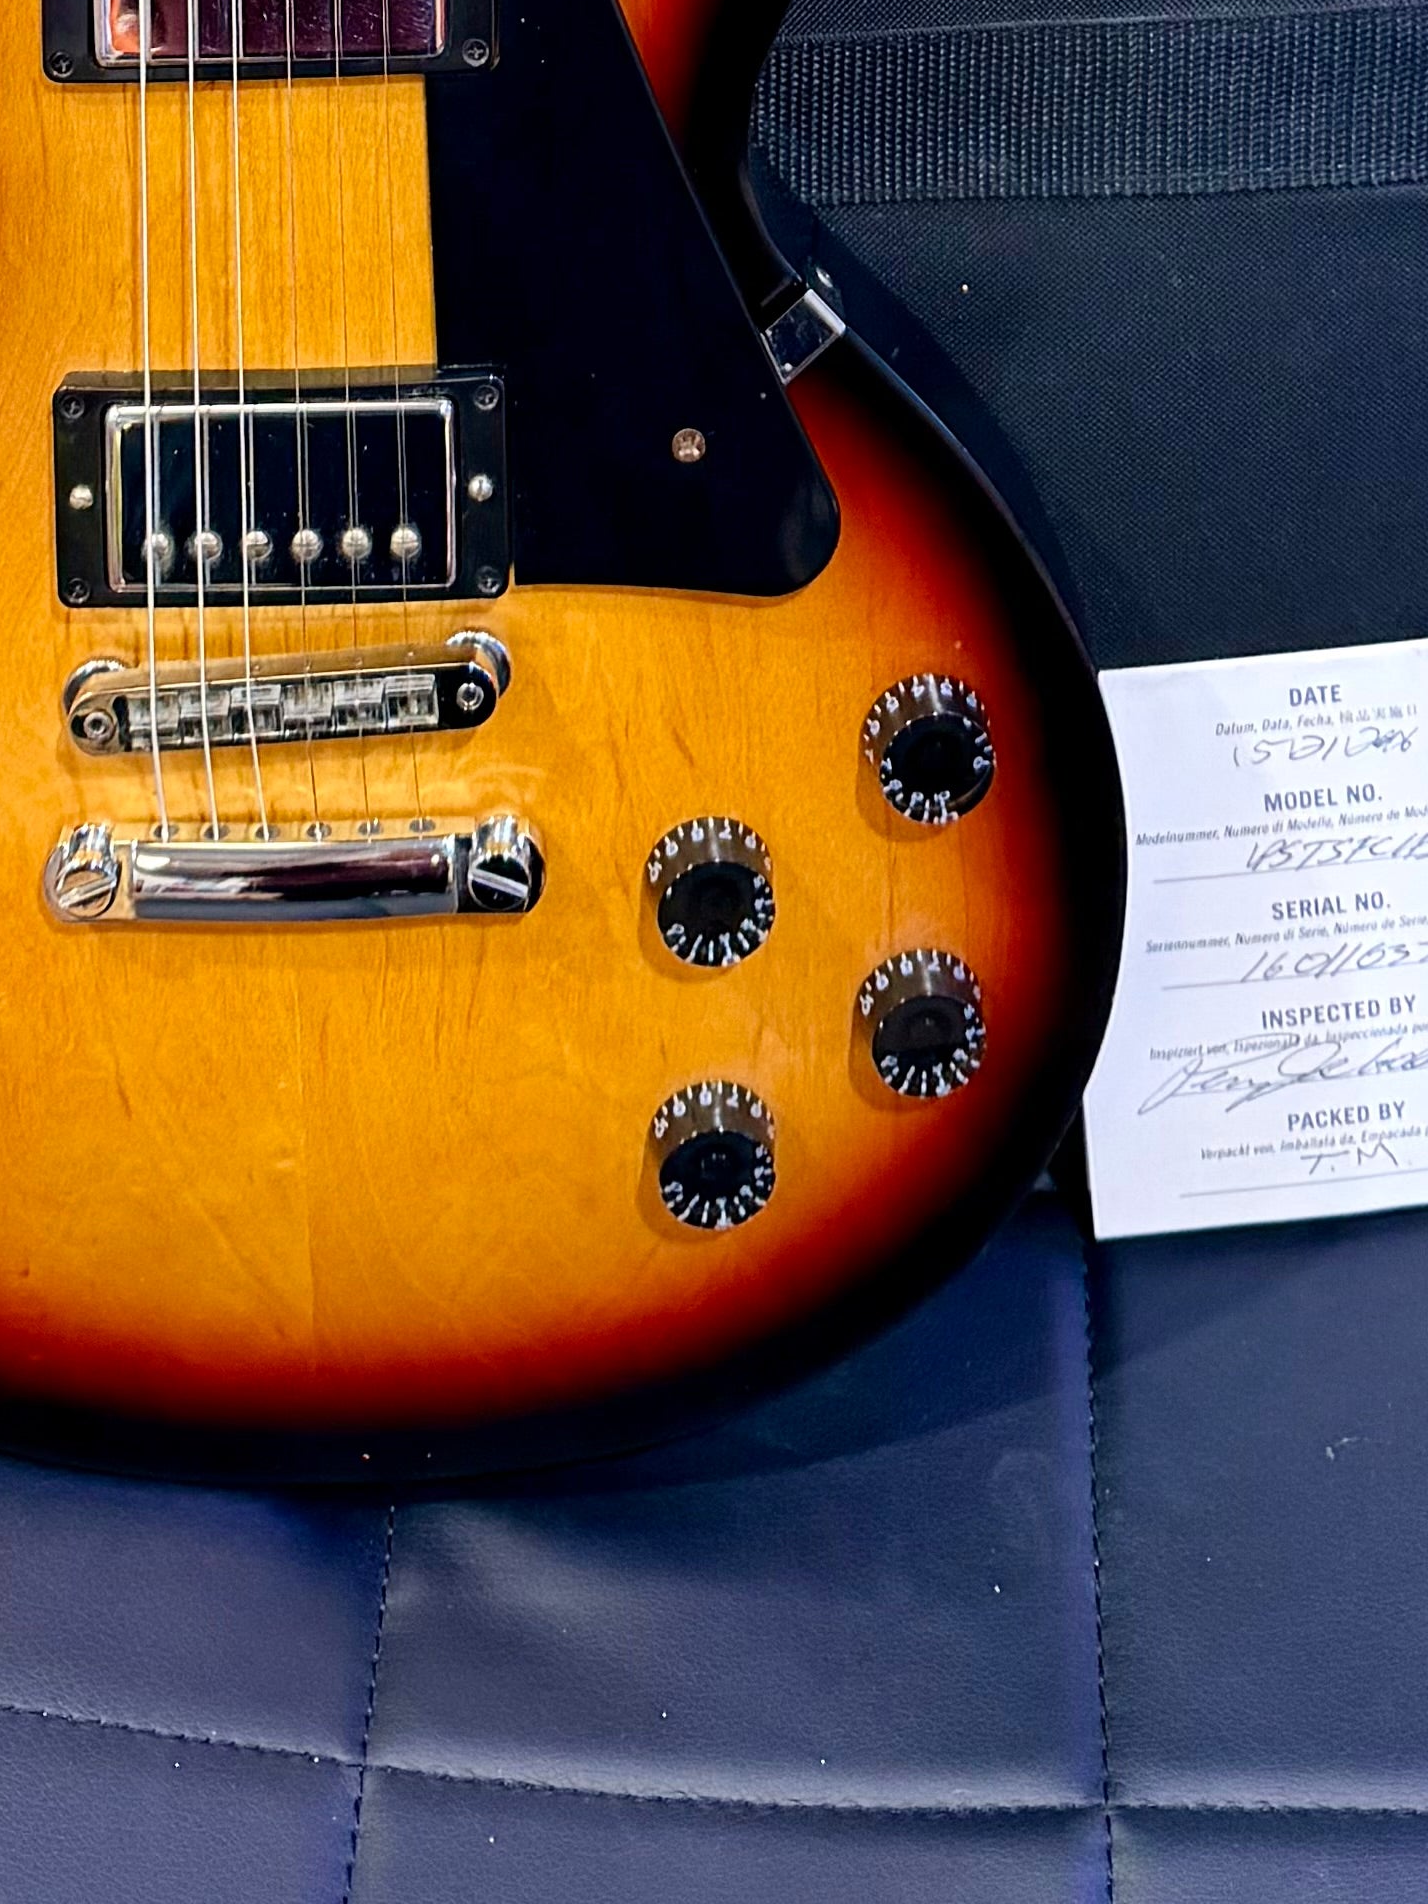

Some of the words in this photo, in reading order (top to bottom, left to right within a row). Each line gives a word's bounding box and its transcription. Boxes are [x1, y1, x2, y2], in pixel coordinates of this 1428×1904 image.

[1289, 684, 1342, 707] DATE
[1263, 787, 1338, 813] MODEL
[1346, 783, 1383, 804] NO.
[1272, 819, 1285, 833] di
[1272, 895, 1348, 921] SERIAL
[1355, 890, 1391, 912] NO.
[1283, 928, 1294, 942] di
[1261, 998, 1381, 1030] INSPECTED
[1389, 993, 1417, 1015] BY
[1288, 1105, 1370, 1132] PACKED
[1378, 1100, 1405, 1122] BY
